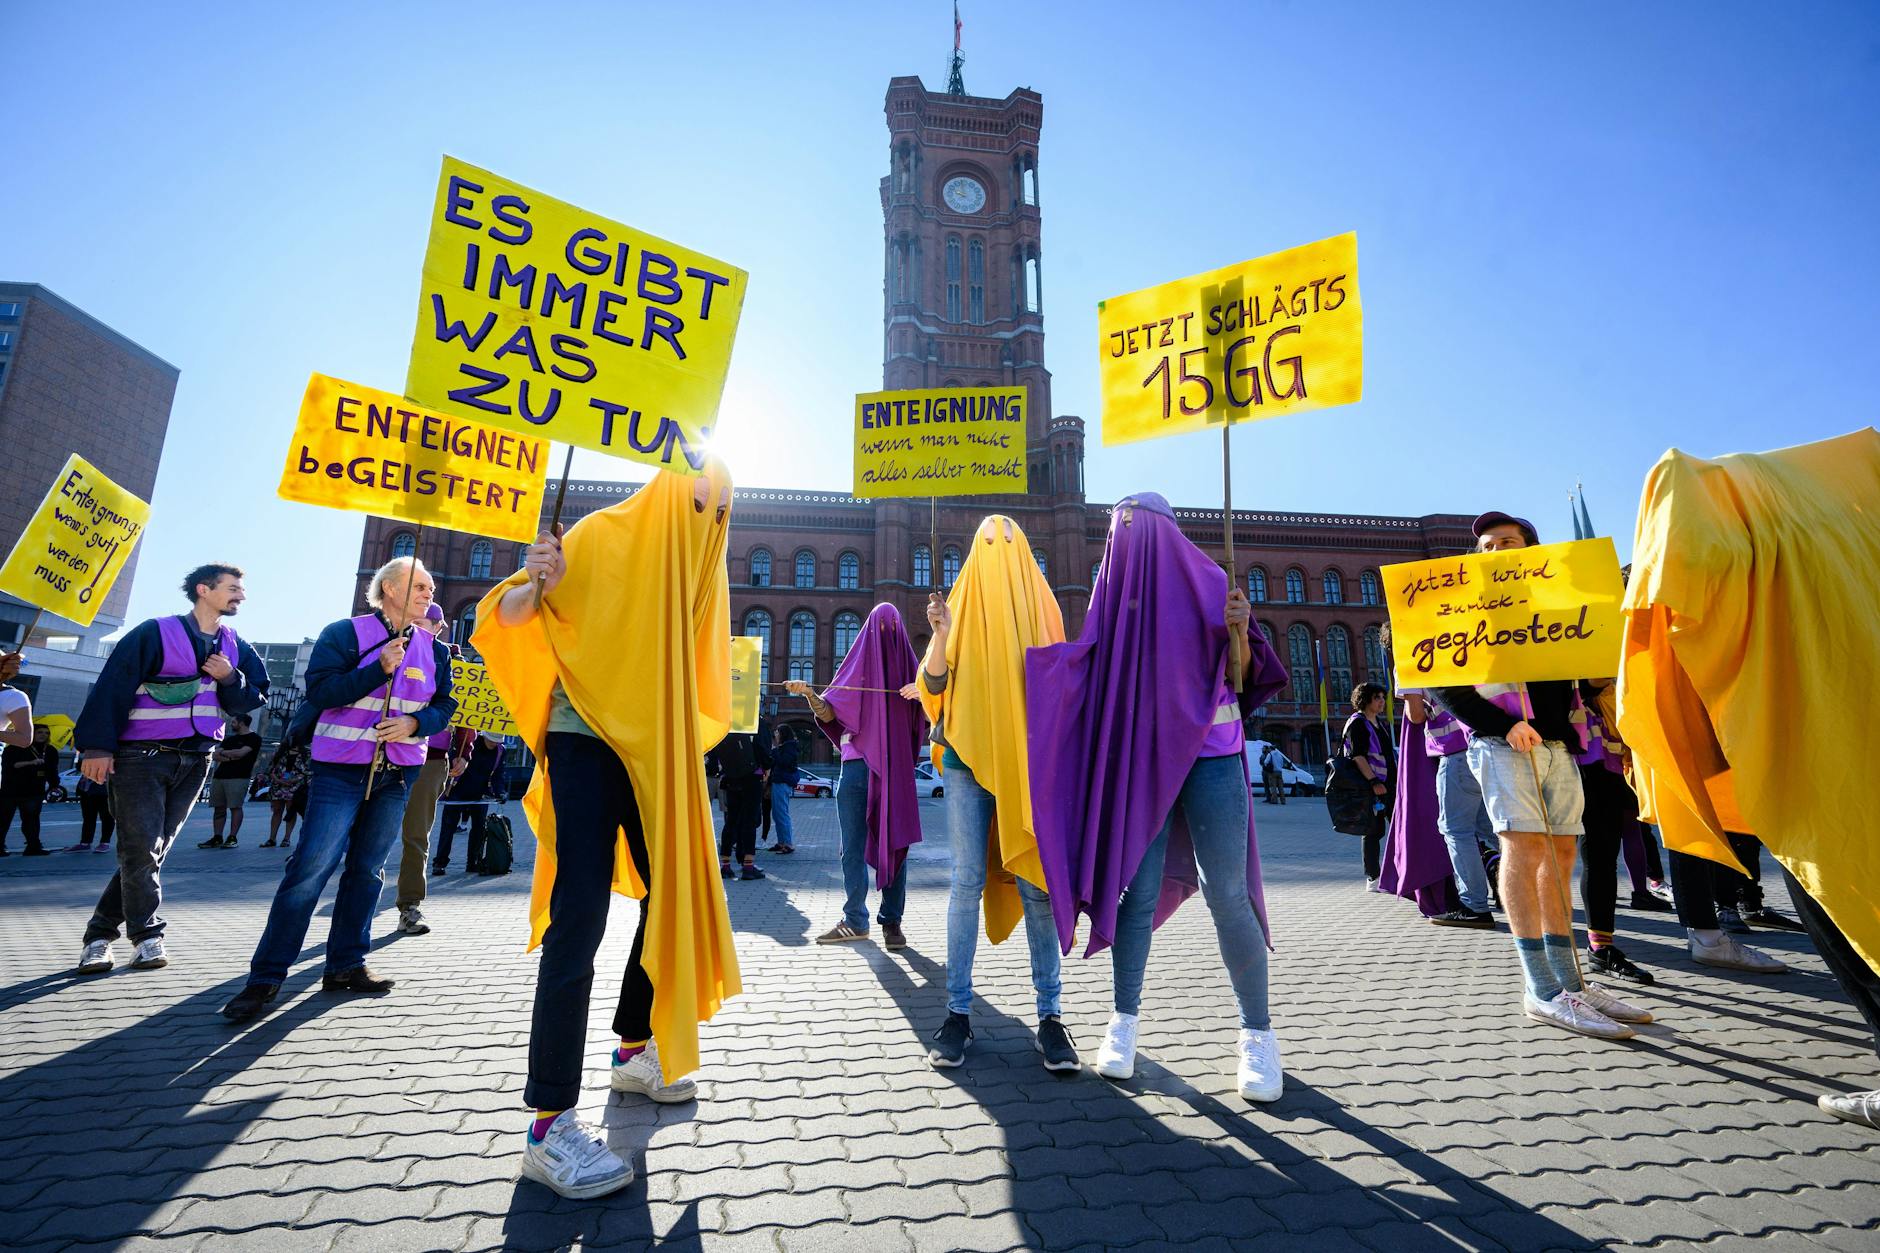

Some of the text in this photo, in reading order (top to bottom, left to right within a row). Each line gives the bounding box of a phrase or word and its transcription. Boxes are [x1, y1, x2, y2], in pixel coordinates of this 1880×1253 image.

[445, 175, 730, 320] ES GIBT
[463, 243, 687, 360] IMMER
[1110, 274, 1347, 358] JETZT SCHLÄGTS
[431, 293, 597, 383] WAS
[335, 396, 539, 474] ENTEIGNEN
[447, 363, 709, 471] ZU TUN
[861, 431, 1011, 455] wenn man nicht
[862, 395, 1022, 429] ENTEIGNUNG
[298, 445, 527, 513] beGEISTERT
[861, 456, 1023, 483] alles selber macht
[47, 542, 90, 575] werden
[1402, 558, 1557, 608] jetzt wird
[1411, 604, 1594, 673] geghosted
